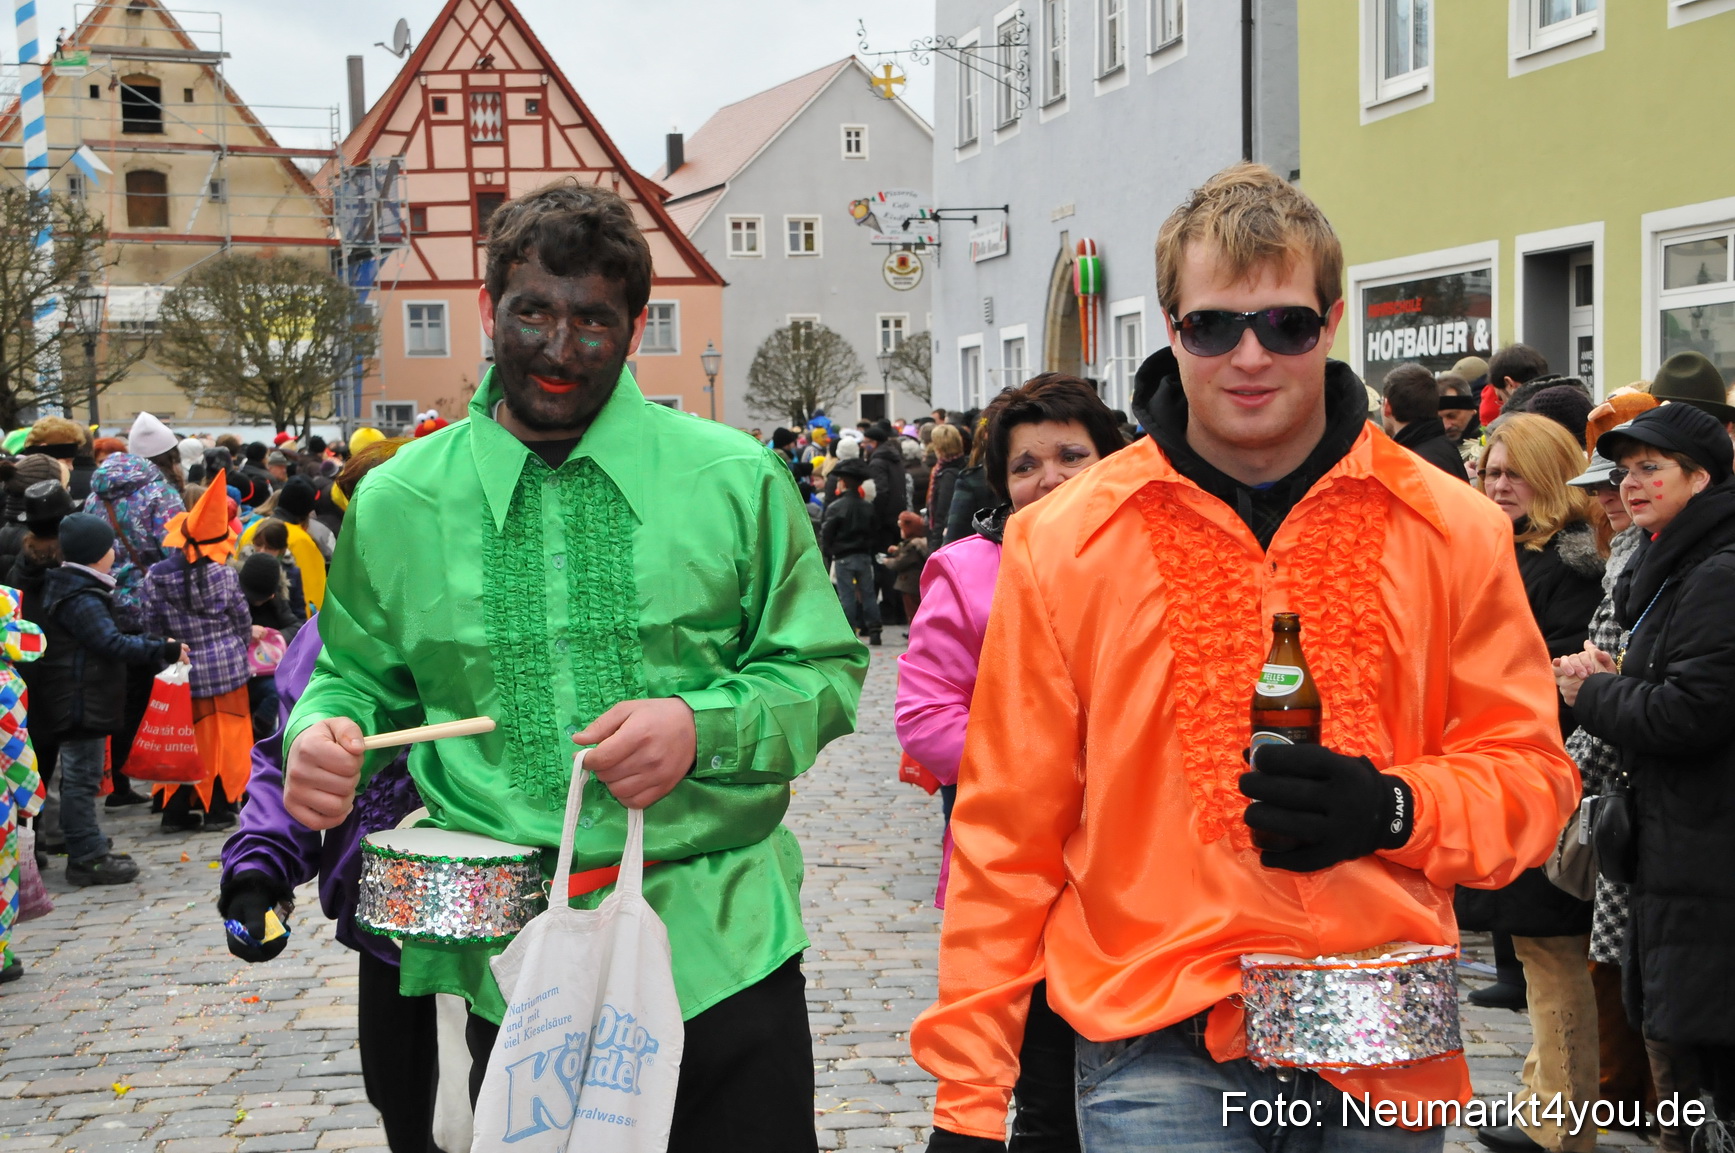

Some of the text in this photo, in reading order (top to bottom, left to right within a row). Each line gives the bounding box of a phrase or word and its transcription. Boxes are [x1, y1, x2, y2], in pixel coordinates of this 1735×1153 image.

[1367, 318, 1489, 362] HOFBAUER &
[1263, 672, 1285, 682] HELLES
[1394, 787, 1404, 818] JAKO
[509, 986, 559, 1017] Natriumarm
[504, 1014, 573, 1050] viel Kieselsäure
[506, 1008, 540, 1033] und mit
